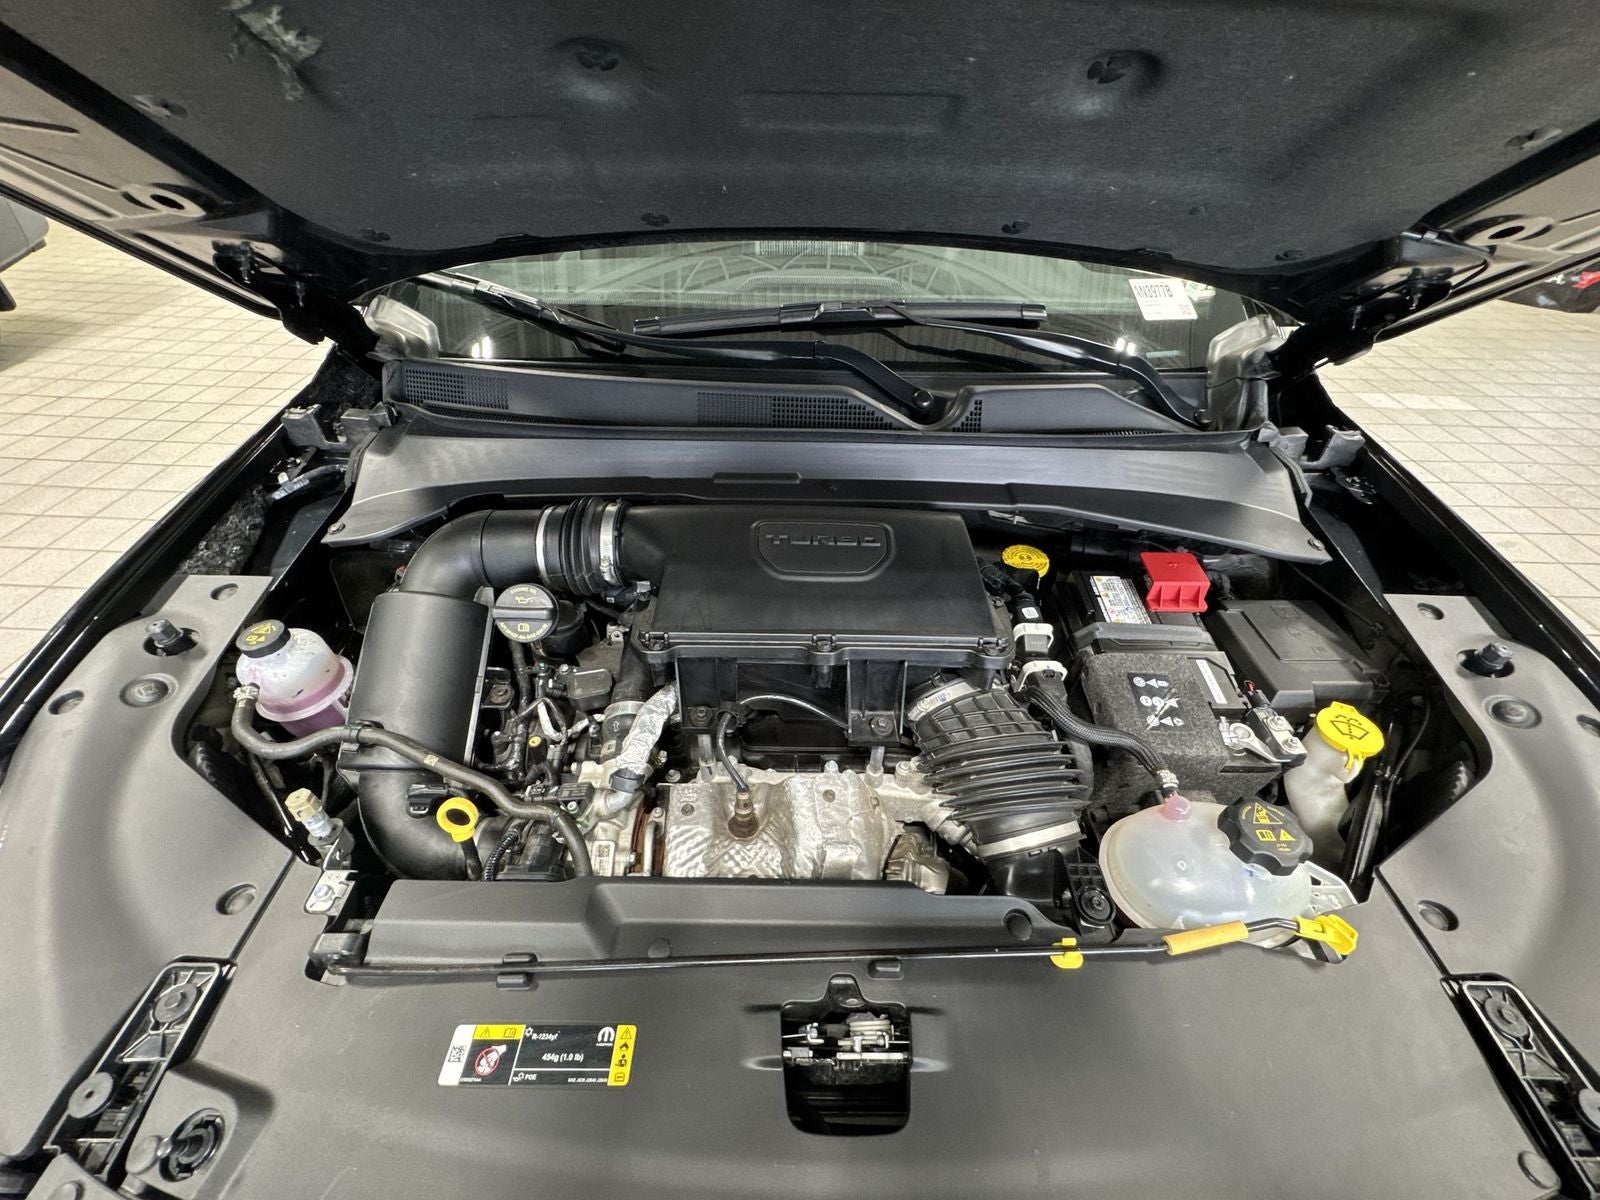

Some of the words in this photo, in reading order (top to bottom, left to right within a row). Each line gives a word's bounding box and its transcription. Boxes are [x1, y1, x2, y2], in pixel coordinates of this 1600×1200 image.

[765, 534, 881, 546] TURBO
[541, 1053, 560, 1063] 454g
[560, 1053, 574, 1063] (1.0
[574, 1053, 584, 1063] lb)
